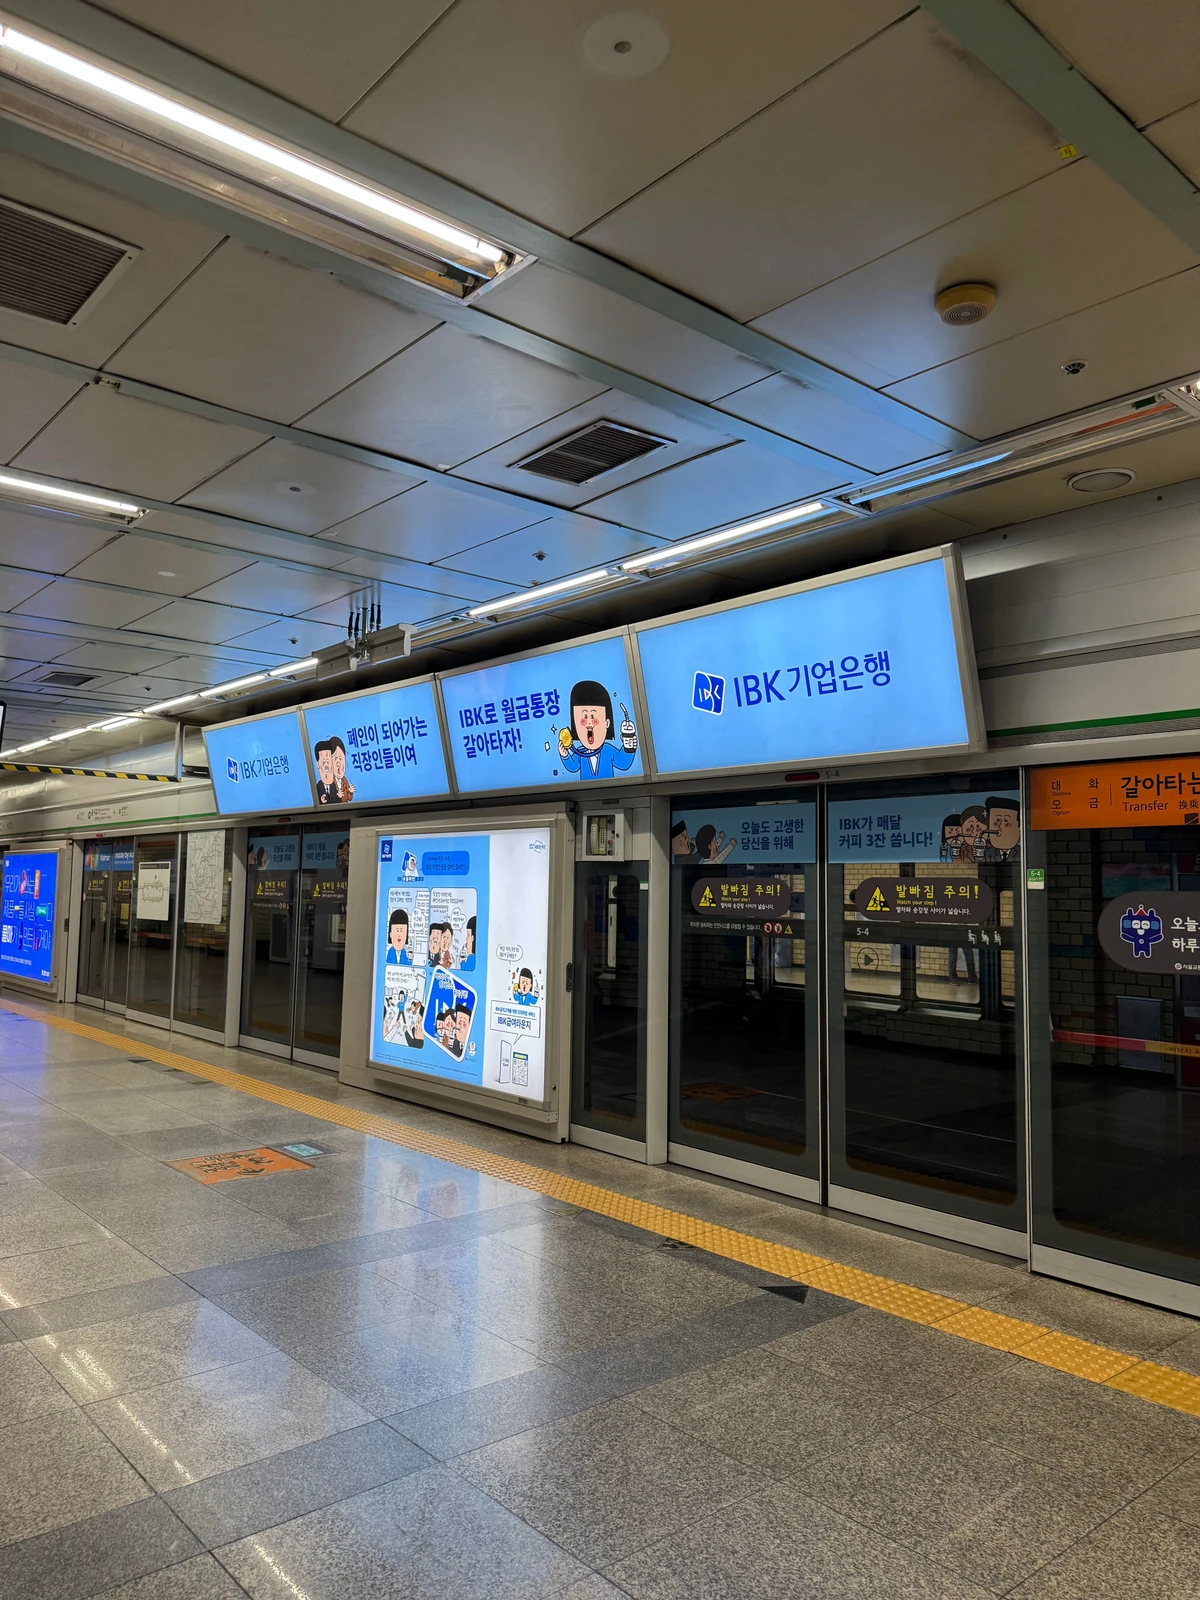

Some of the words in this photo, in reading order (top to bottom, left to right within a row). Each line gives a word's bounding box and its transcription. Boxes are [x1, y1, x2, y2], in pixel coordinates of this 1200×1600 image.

[459, 702, 499, 728] IBK로
[501, 688, 560, 725] 월급통장
[382, 715, 428, 742] 되어가는
[463, 727, 523, 759] 갈아타자!
[351, 743, 418, 773] 직장인들이여
[825, 770, 840, 778] 5-4
[1121, 771, 1200, 799] 갈아타는
[1122, 800, 1169, 812] Transfer
[740, 820, 771, 835] 오늘도
[773, 818, 804, 834] 고생한
[839, 815, 873, 831] IBK가
[877, 814, 902, 830] 매달
[740, 836, 771, 851] 당신을
[773, 835, 794, 850] 위해
[838, 834, 862, 849] 커피
[866, 833, 887, 847] 3잔
[889, 831, 933, 848] 쏩니다!
[720, 883, 749, 896] 발빠짐
[755, 883, 781, 897] 주의!
[896, 884, 935, 899] 발빠짐
[943, 884, 979, 899] 주의!
[895, 906, 911, 914] 열차와
[912, 906, 929, 914] 승강장
[929, 907, 947, 915] 사이가
[947, 908, 972, 916] 넓습니다.
[856, 927, 870, 936] 5-4
[1170, 916, 1200, 932] 오늘
